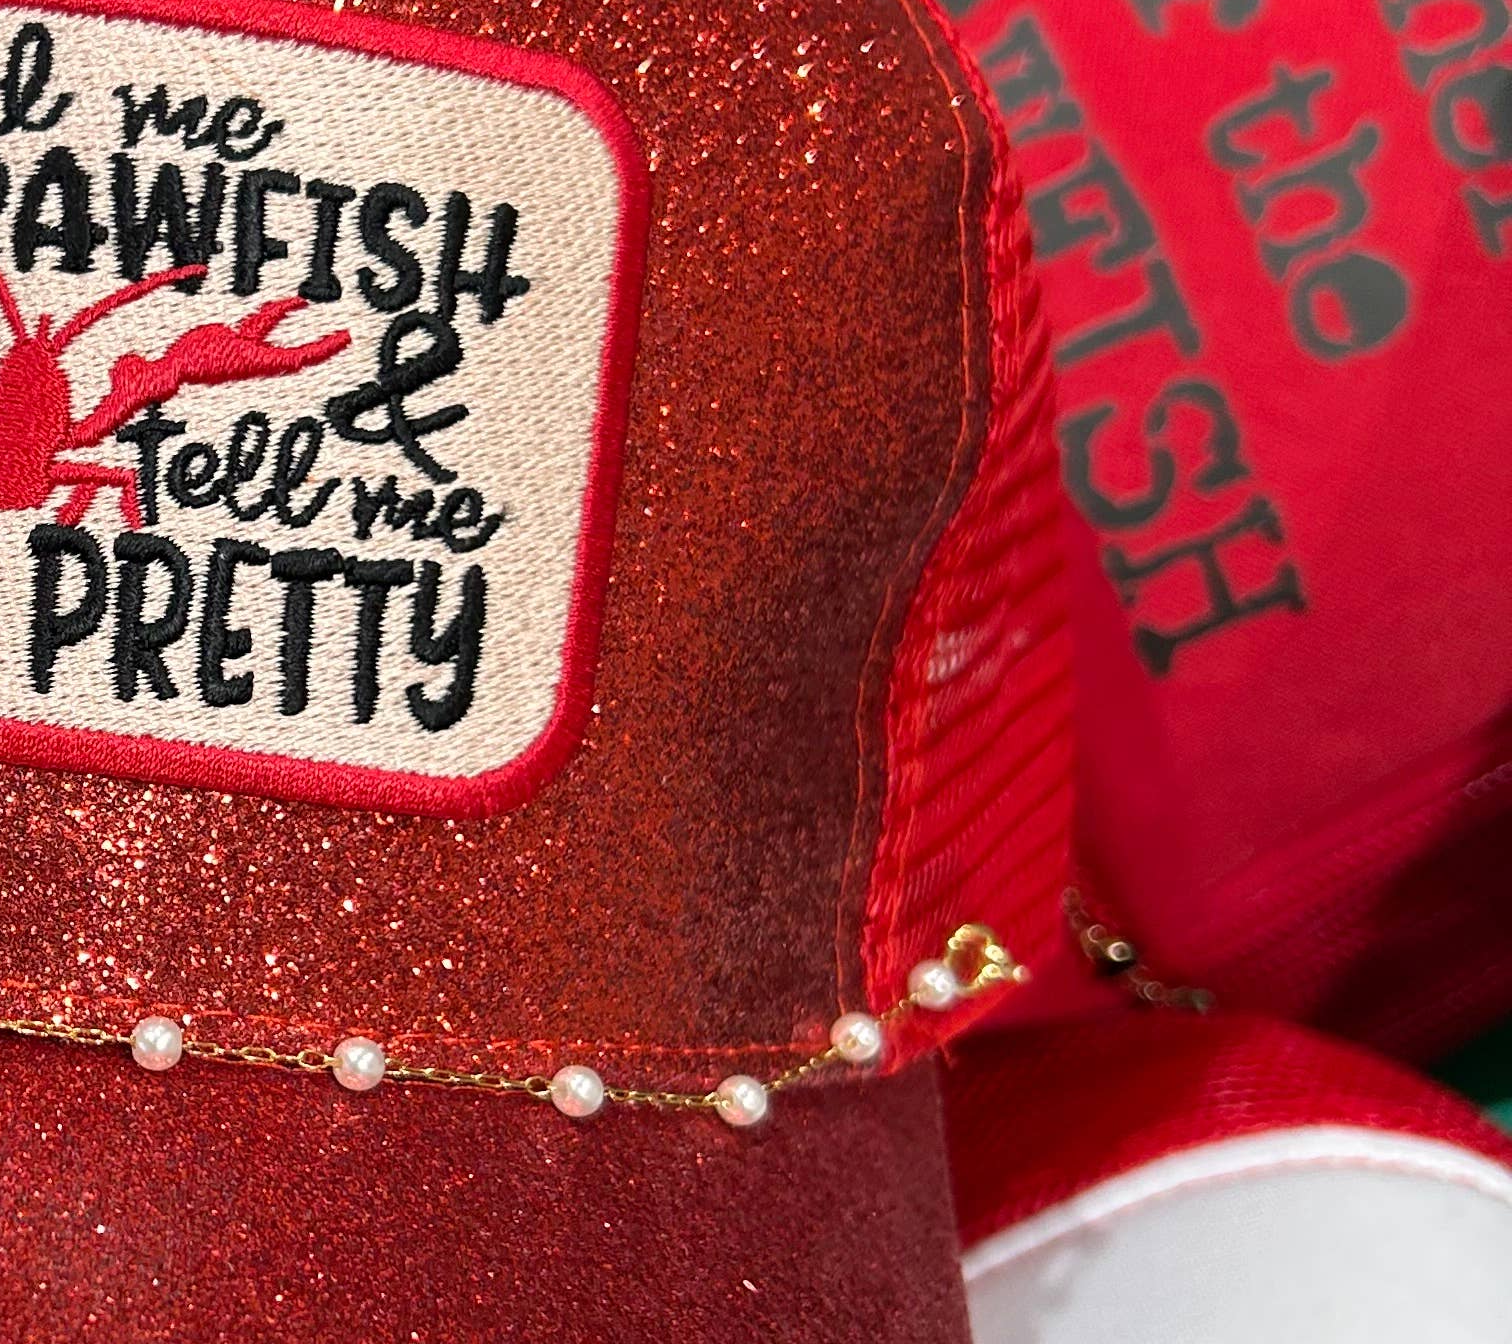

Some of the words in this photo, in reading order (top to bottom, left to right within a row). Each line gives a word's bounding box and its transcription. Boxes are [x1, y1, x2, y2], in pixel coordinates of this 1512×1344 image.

[112, 81, 286, 163] me
[117, 400, 340, 528] tell
[350, 474, 506, 555] me
[322, 310, 470, 482] &
[25, 523, 488, 732] PRETTY
